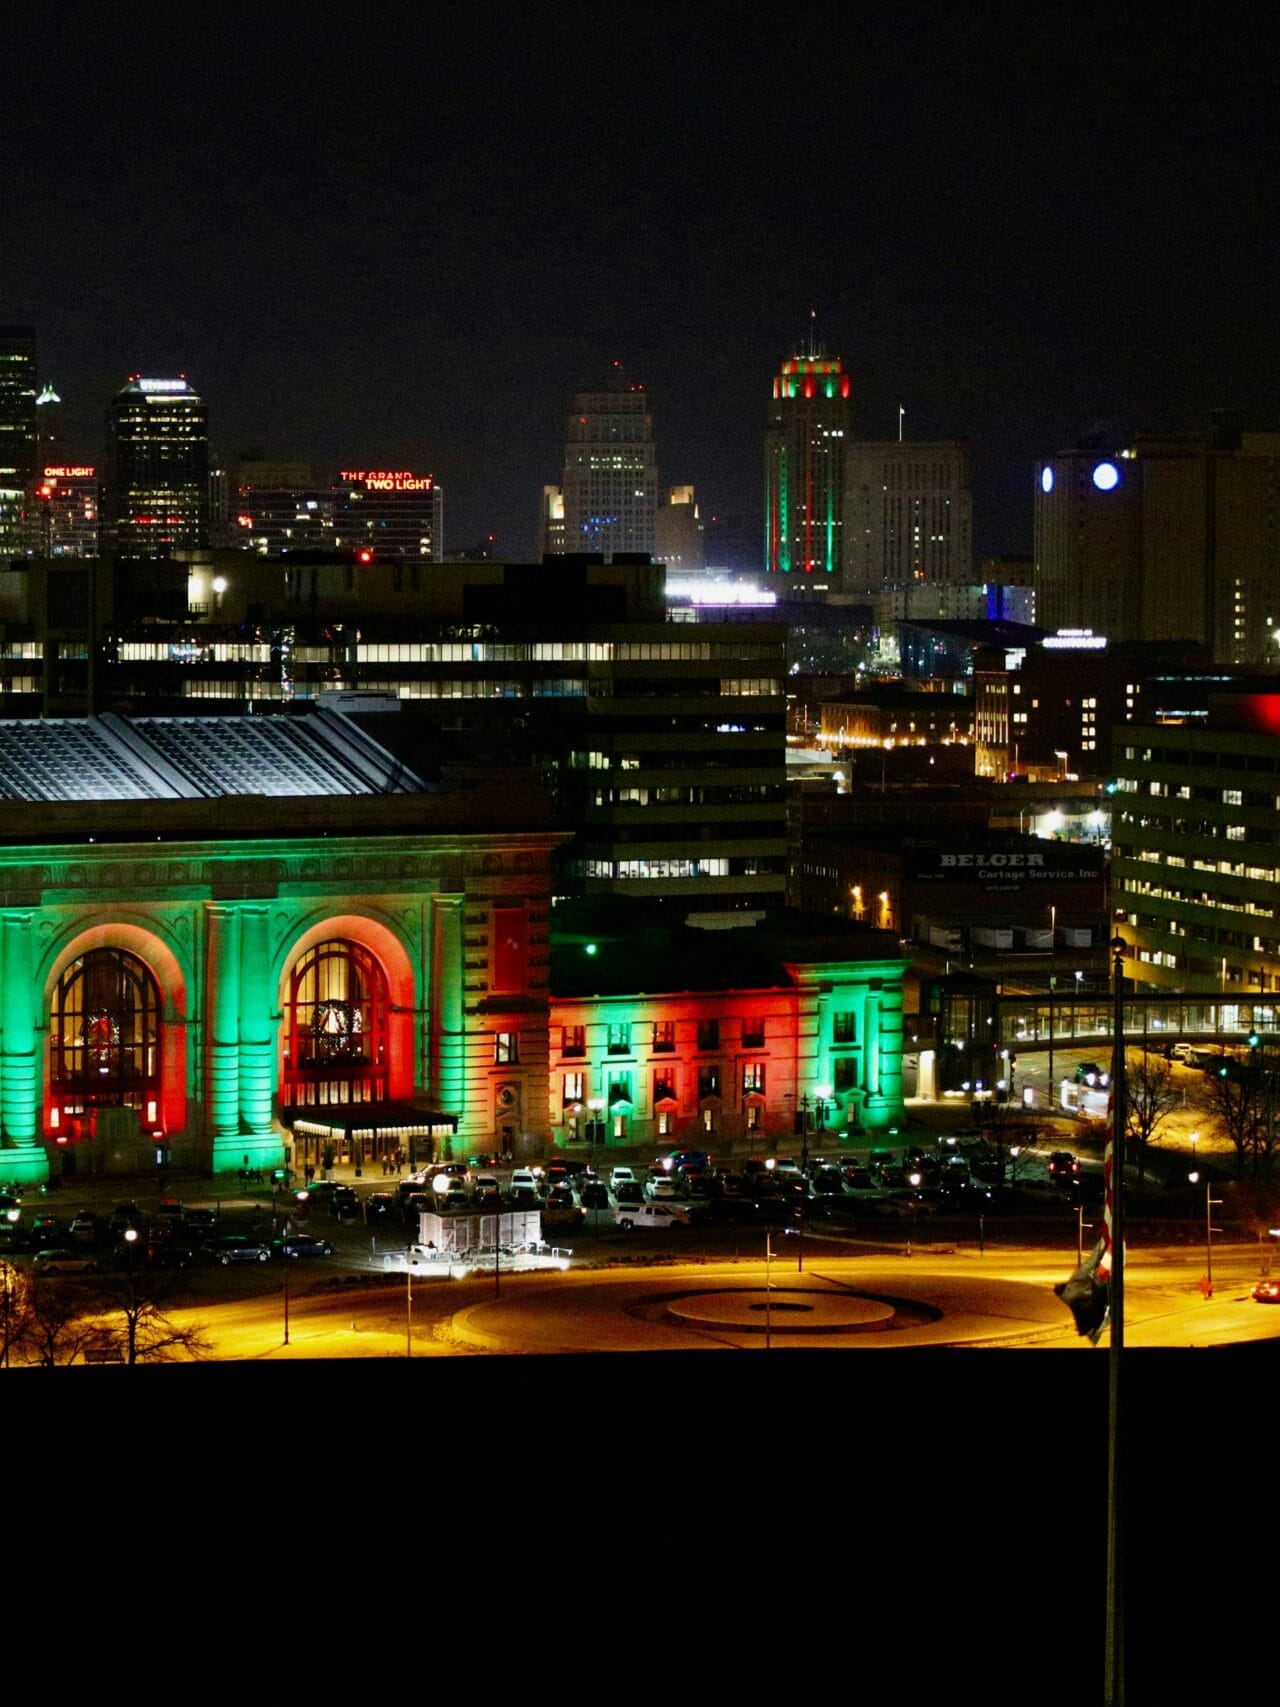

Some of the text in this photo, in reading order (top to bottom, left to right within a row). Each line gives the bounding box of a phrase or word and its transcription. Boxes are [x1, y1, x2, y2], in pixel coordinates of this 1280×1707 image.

[44, 467, 95, 477] ONE LIGHT
[340, 472, 412, 481] THE GRAND
[365, 479, 432, 490] TWO LIGHT
[939, 853, 1045, 867] BELGER
[978, 869, 1026, 881] Cartage
